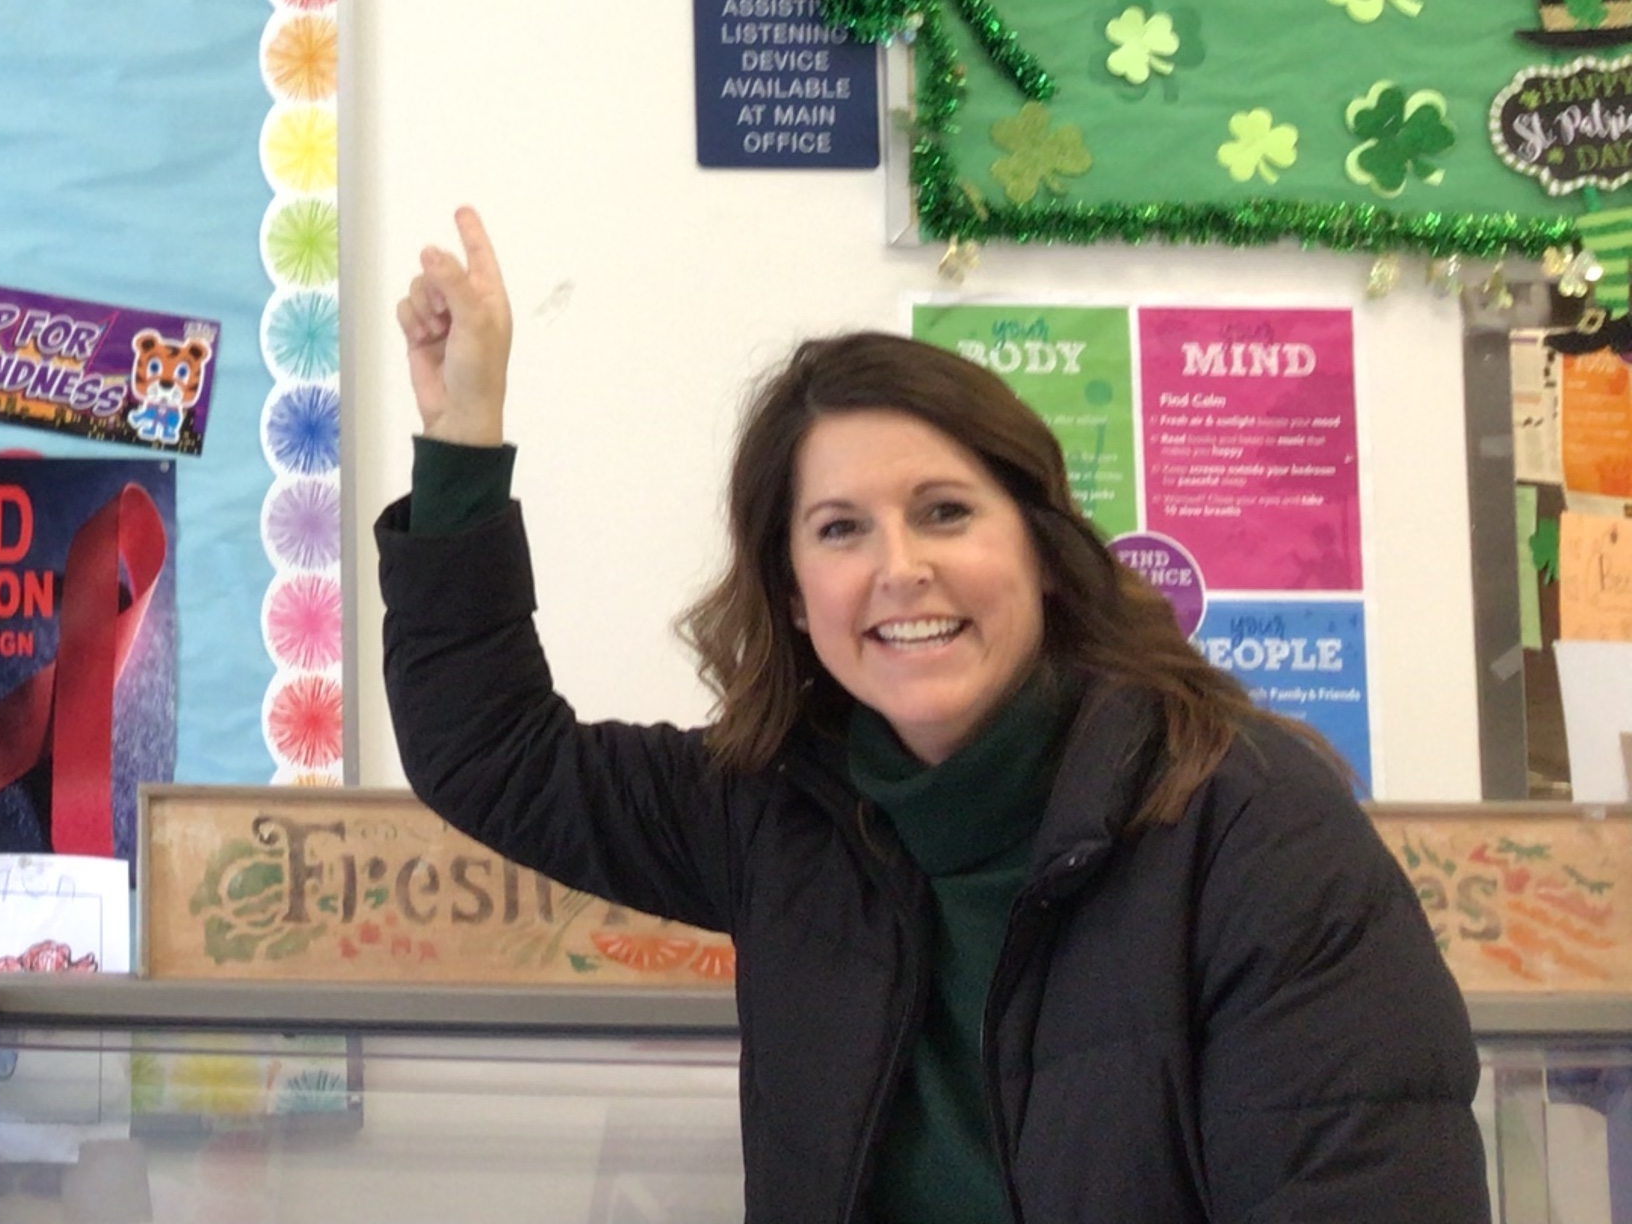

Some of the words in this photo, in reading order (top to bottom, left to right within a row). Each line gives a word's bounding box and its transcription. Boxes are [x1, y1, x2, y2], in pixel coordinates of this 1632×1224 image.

[721, 23, 849, 45] LISTENING
[741, 50, 830, 73] DEVICE
[721, 78, 851, 100] AVAILABLE
[736, 105, 766, 126] AT
[773, 105, 836, 126] MAIN
[742, 132, 832, 154] OFFICE
[19, 308, 103, 359] FOR
[1180, 340, 1318, 378] MIND
[1159, 392, 1189, 408] Find
[1191, 392, 1227, 409] Calm
[1211, 445, 1244, 460] happy
[1270, 687, 1308, 704] Family
[1318, 687, 1362, 703] Friends
[251, 814, 556, 926] Fresh
